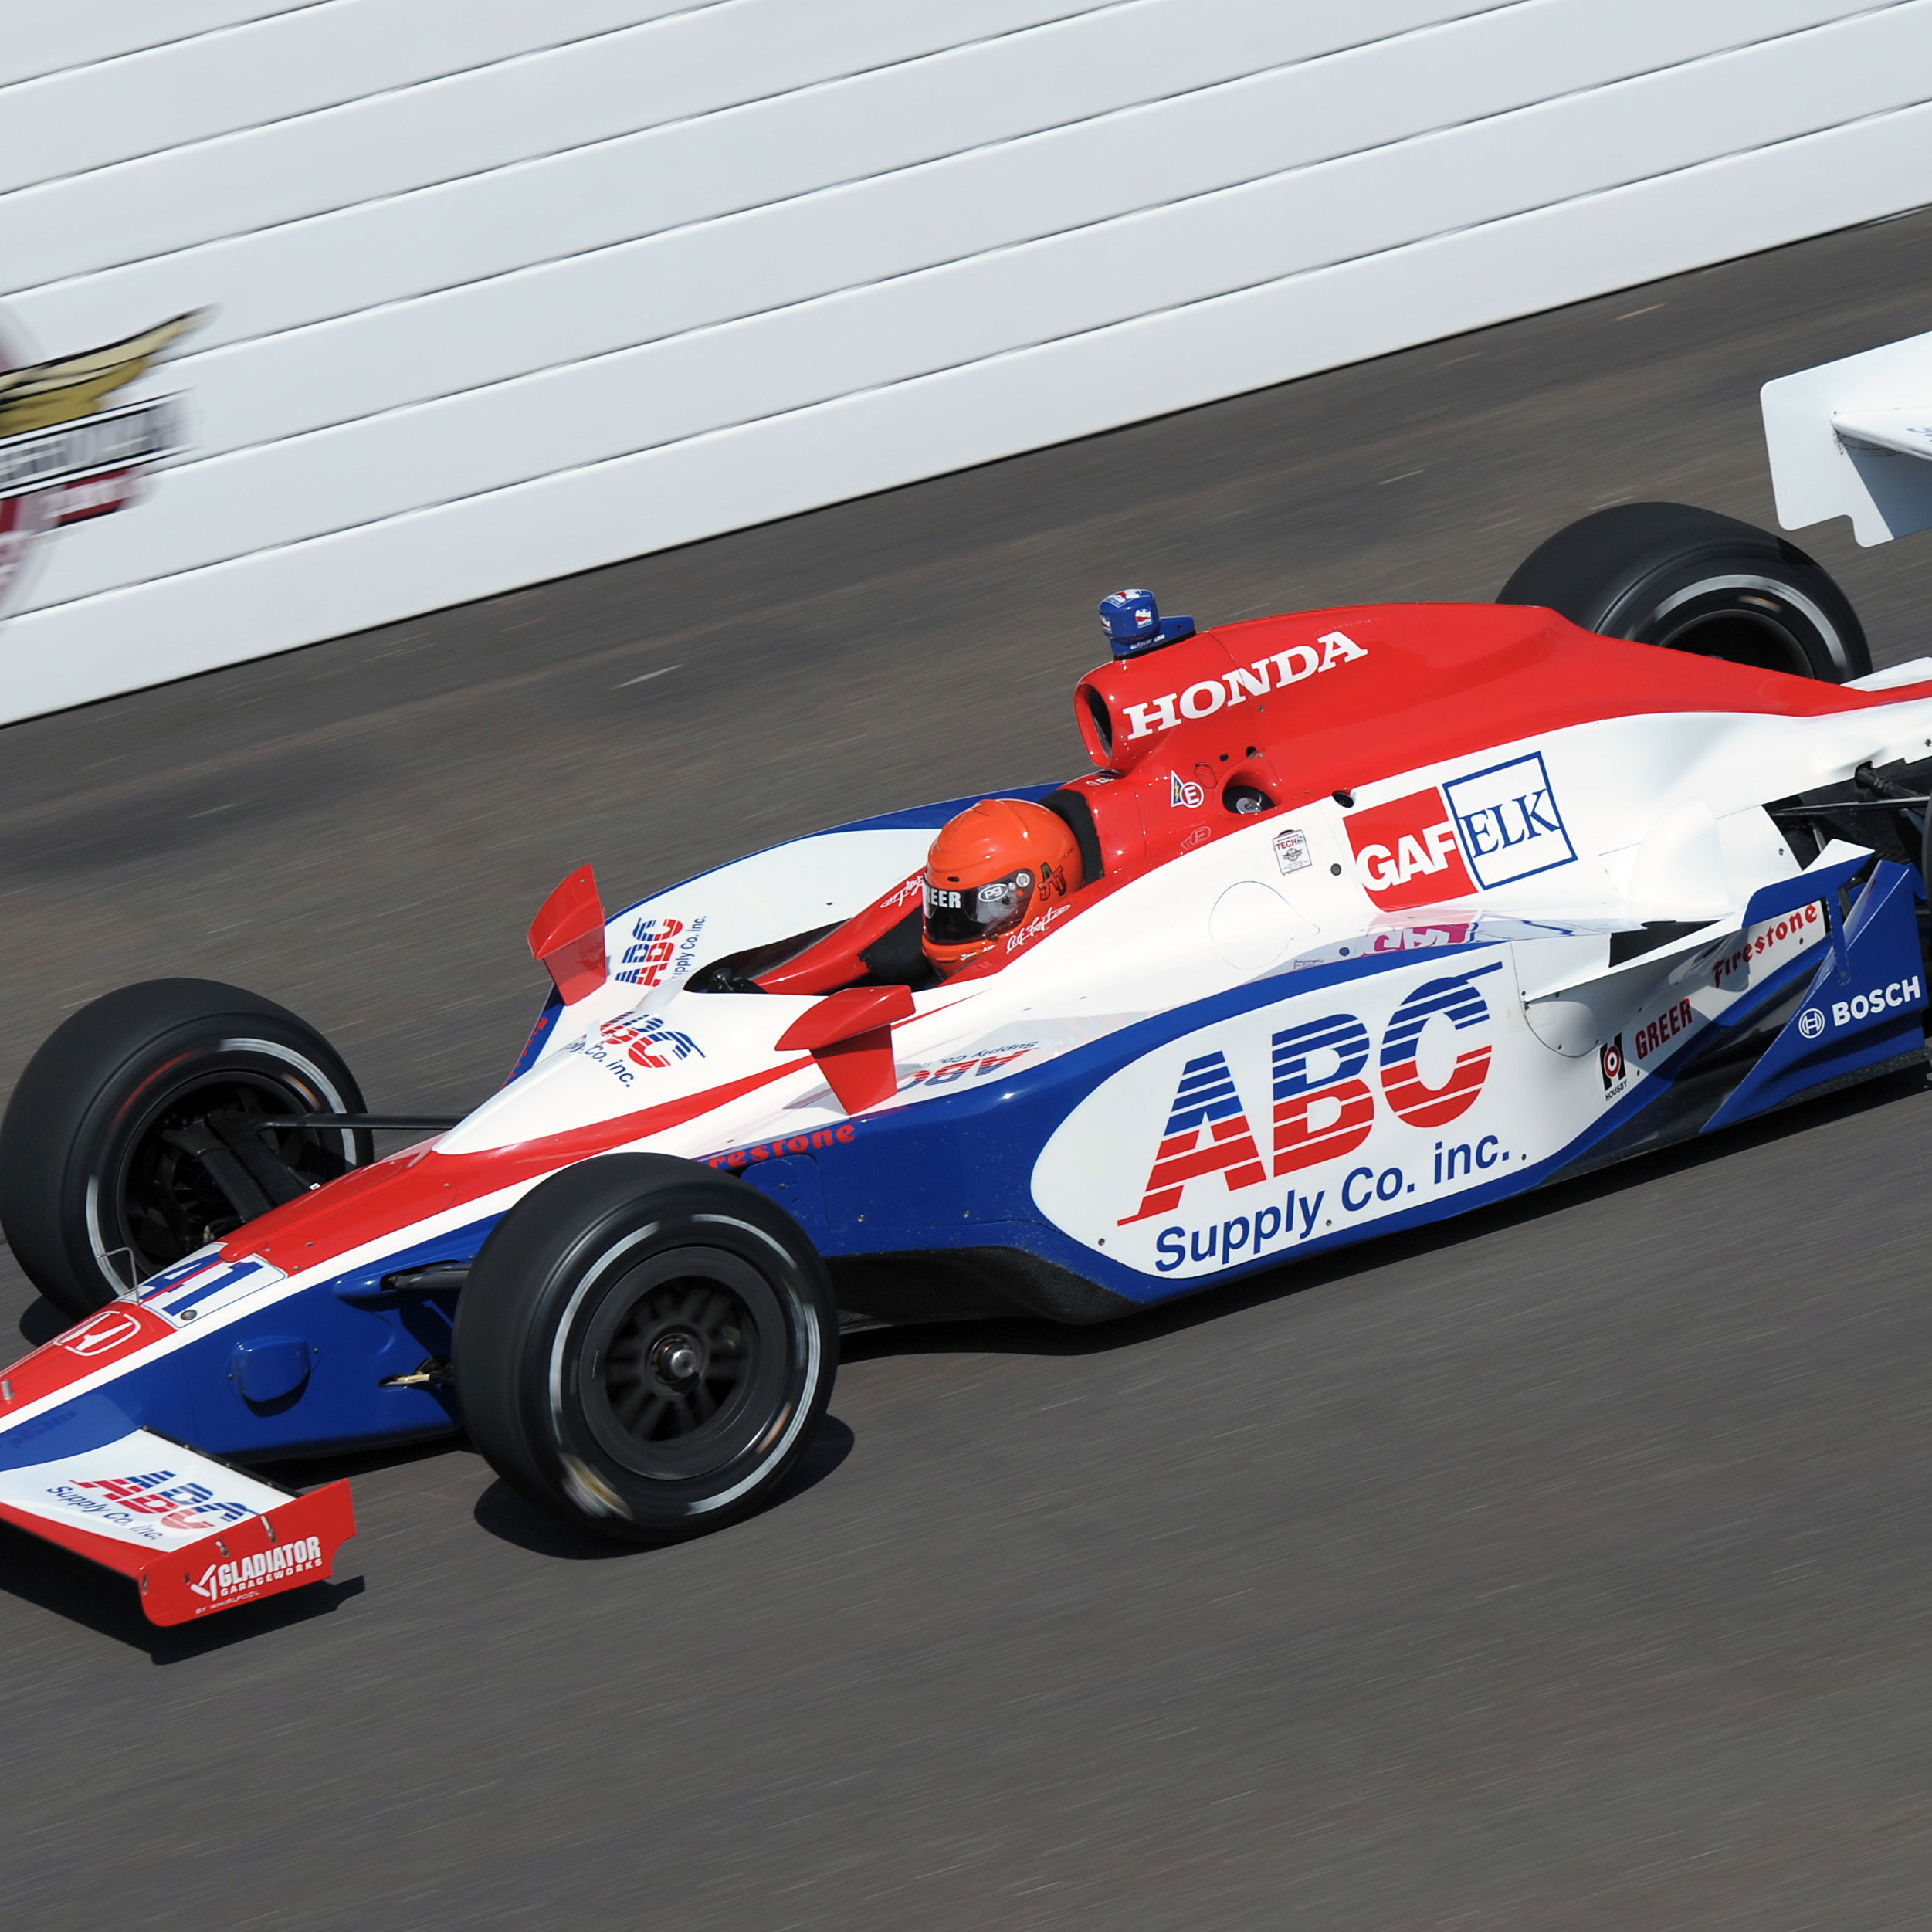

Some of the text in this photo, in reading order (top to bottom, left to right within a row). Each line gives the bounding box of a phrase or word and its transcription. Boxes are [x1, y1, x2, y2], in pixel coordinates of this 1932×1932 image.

[1123, 631, 1368, 740] HONDA
[1459, 788, 1562, 859] ELK
[1356, 821, 1457, 892] GAF
[927, 888, 961, 909] EER
[615, 917, 683, 988] ABC
[680, 934, 699, 950] Co.
[1711, 903, 1818, 989] Firestone
[1635, 998, 1693, 1060] GREER
[1832, 976, 1921, 1027] BOSCH
[1117, 961, 1503, 1227] ABC
[708, 1124, 856, 1168] restone
[1154, 1135, 1510, 1272] Supply Co. inc.
[46, 1486, 112, 1513] Supply
[103, 1511, 134, 1527] Co.
[69, 1470, 260, 1530] ABC
[218, 1536, 322, 1587] GLADIATOR
[220, 1558, 323, 1598] GARAGEWORKS
